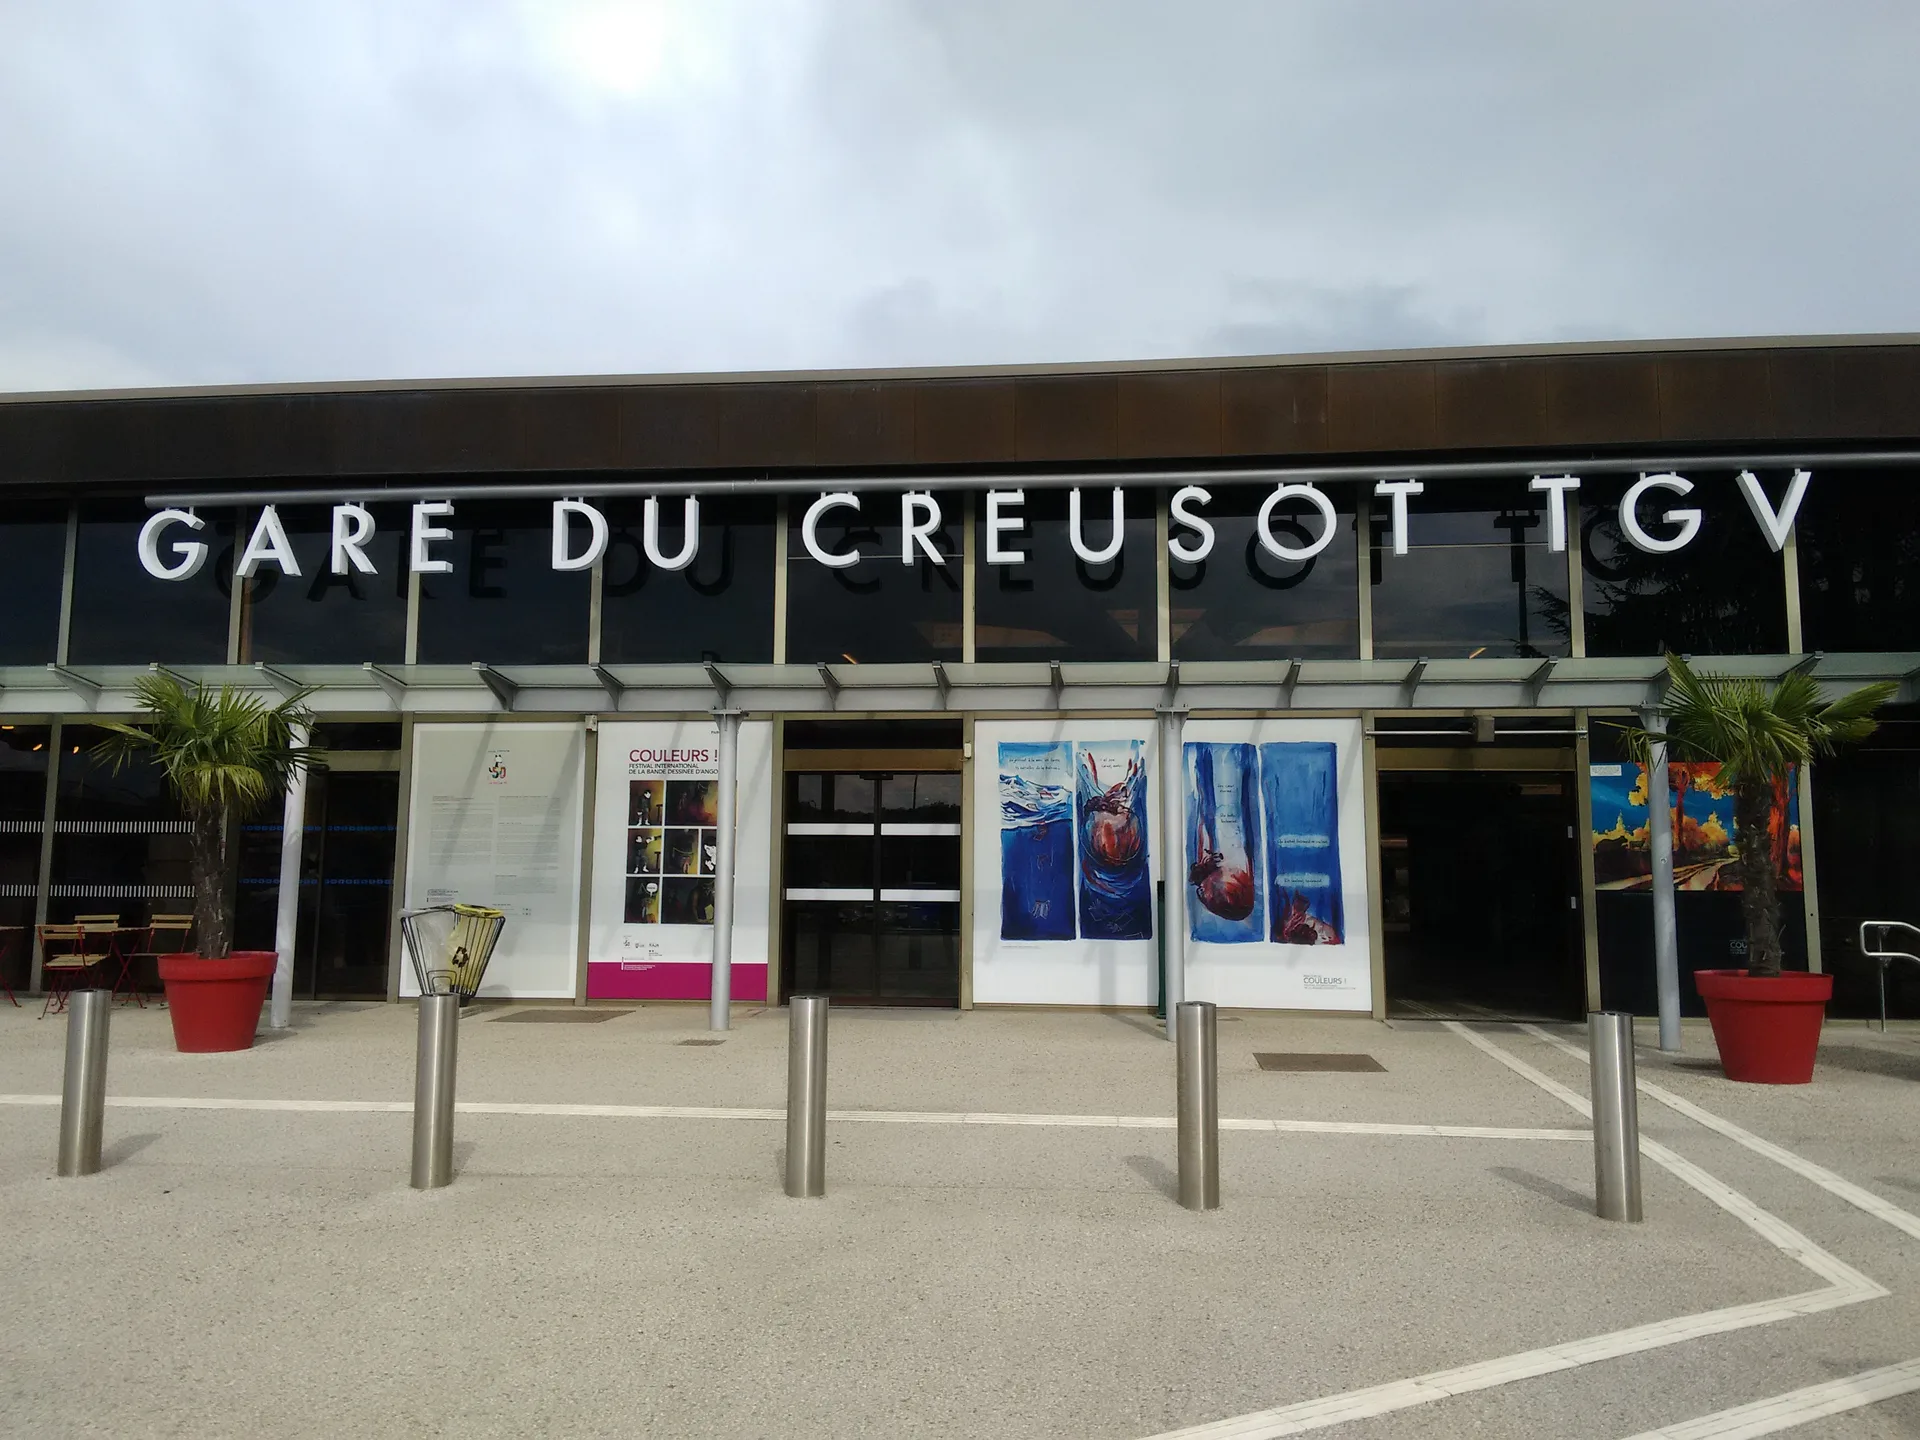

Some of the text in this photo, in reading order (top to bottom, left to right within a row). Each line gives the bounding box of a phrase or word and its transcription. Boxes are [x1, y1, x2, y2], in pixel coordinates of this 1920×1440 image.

[137, 471, 1812, 580] GARE DU CREUSOT TGV
[629, 749, 718, 762] COULEURS !
[1303, 977, 1342, 985] COULEURS
